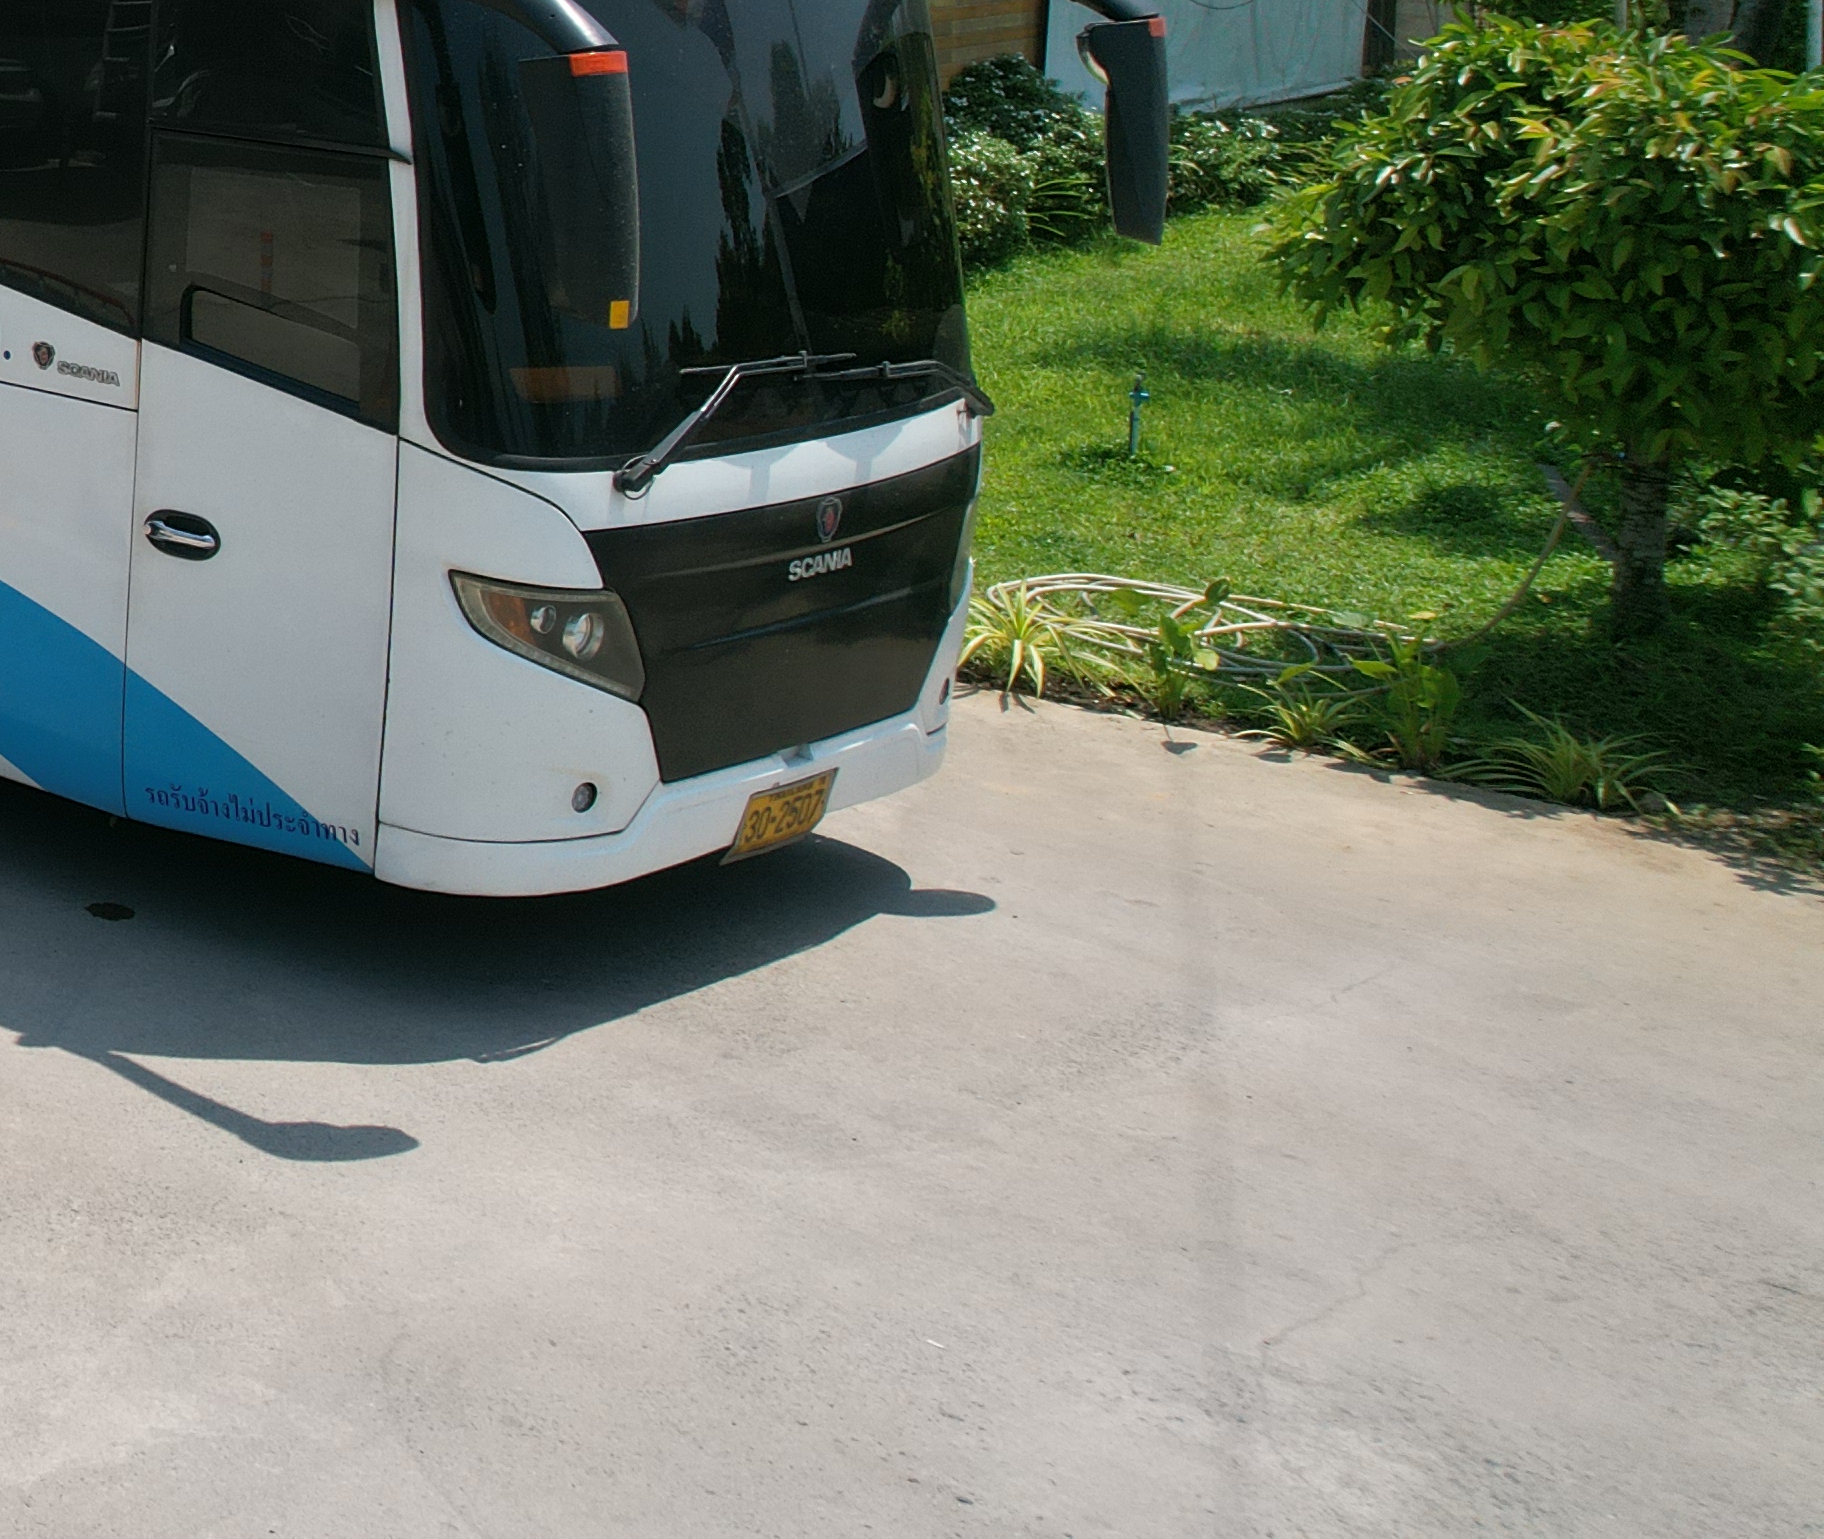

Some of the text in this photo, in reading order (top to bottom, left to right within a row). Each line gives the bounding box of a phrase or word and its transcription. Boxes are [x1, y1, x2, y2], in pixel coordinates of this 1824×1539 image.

[57, 360, 120, 387] SCANIA
[788, 547, 853, 581] SCANIA
[145, 783, 360, 846] รถรับจ้างไม่ประจำทาง
